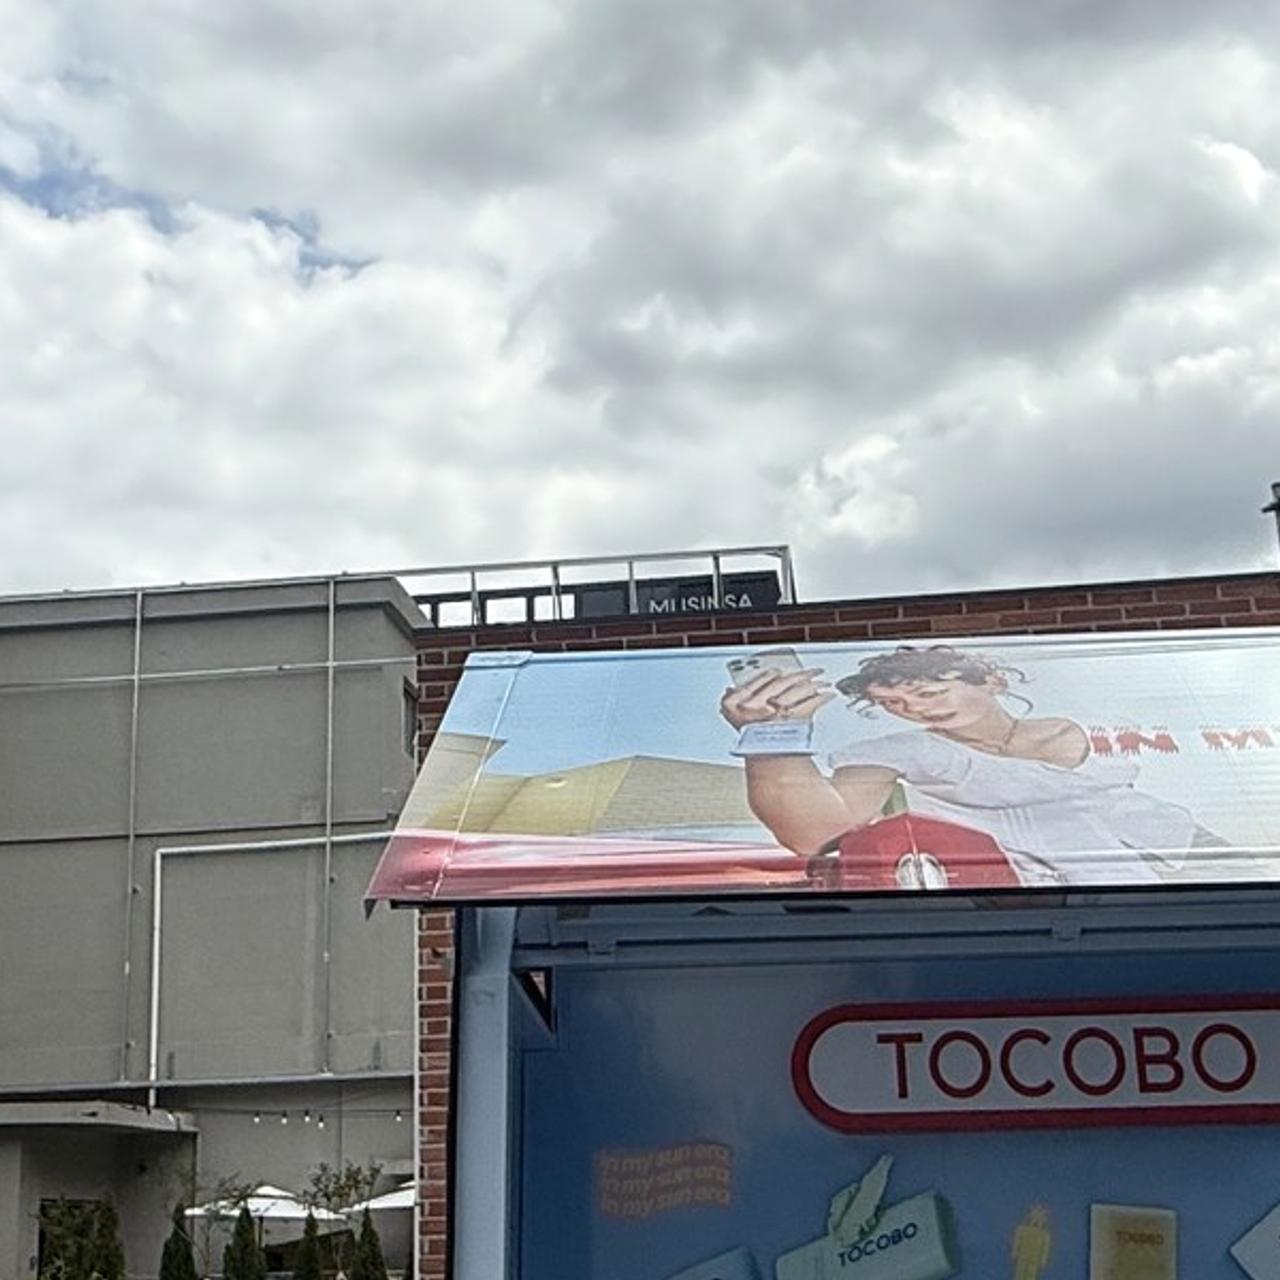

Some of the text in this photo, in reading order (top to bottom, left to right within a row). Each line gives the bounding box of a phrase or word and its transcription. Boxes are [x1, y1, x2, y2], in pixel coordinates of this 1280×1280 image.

[1087, 724, 1180, 759] IN
[876, 1023, 1257, 1100] TOCOBO
[837, 1222, 919, 1268] TOCOBO
